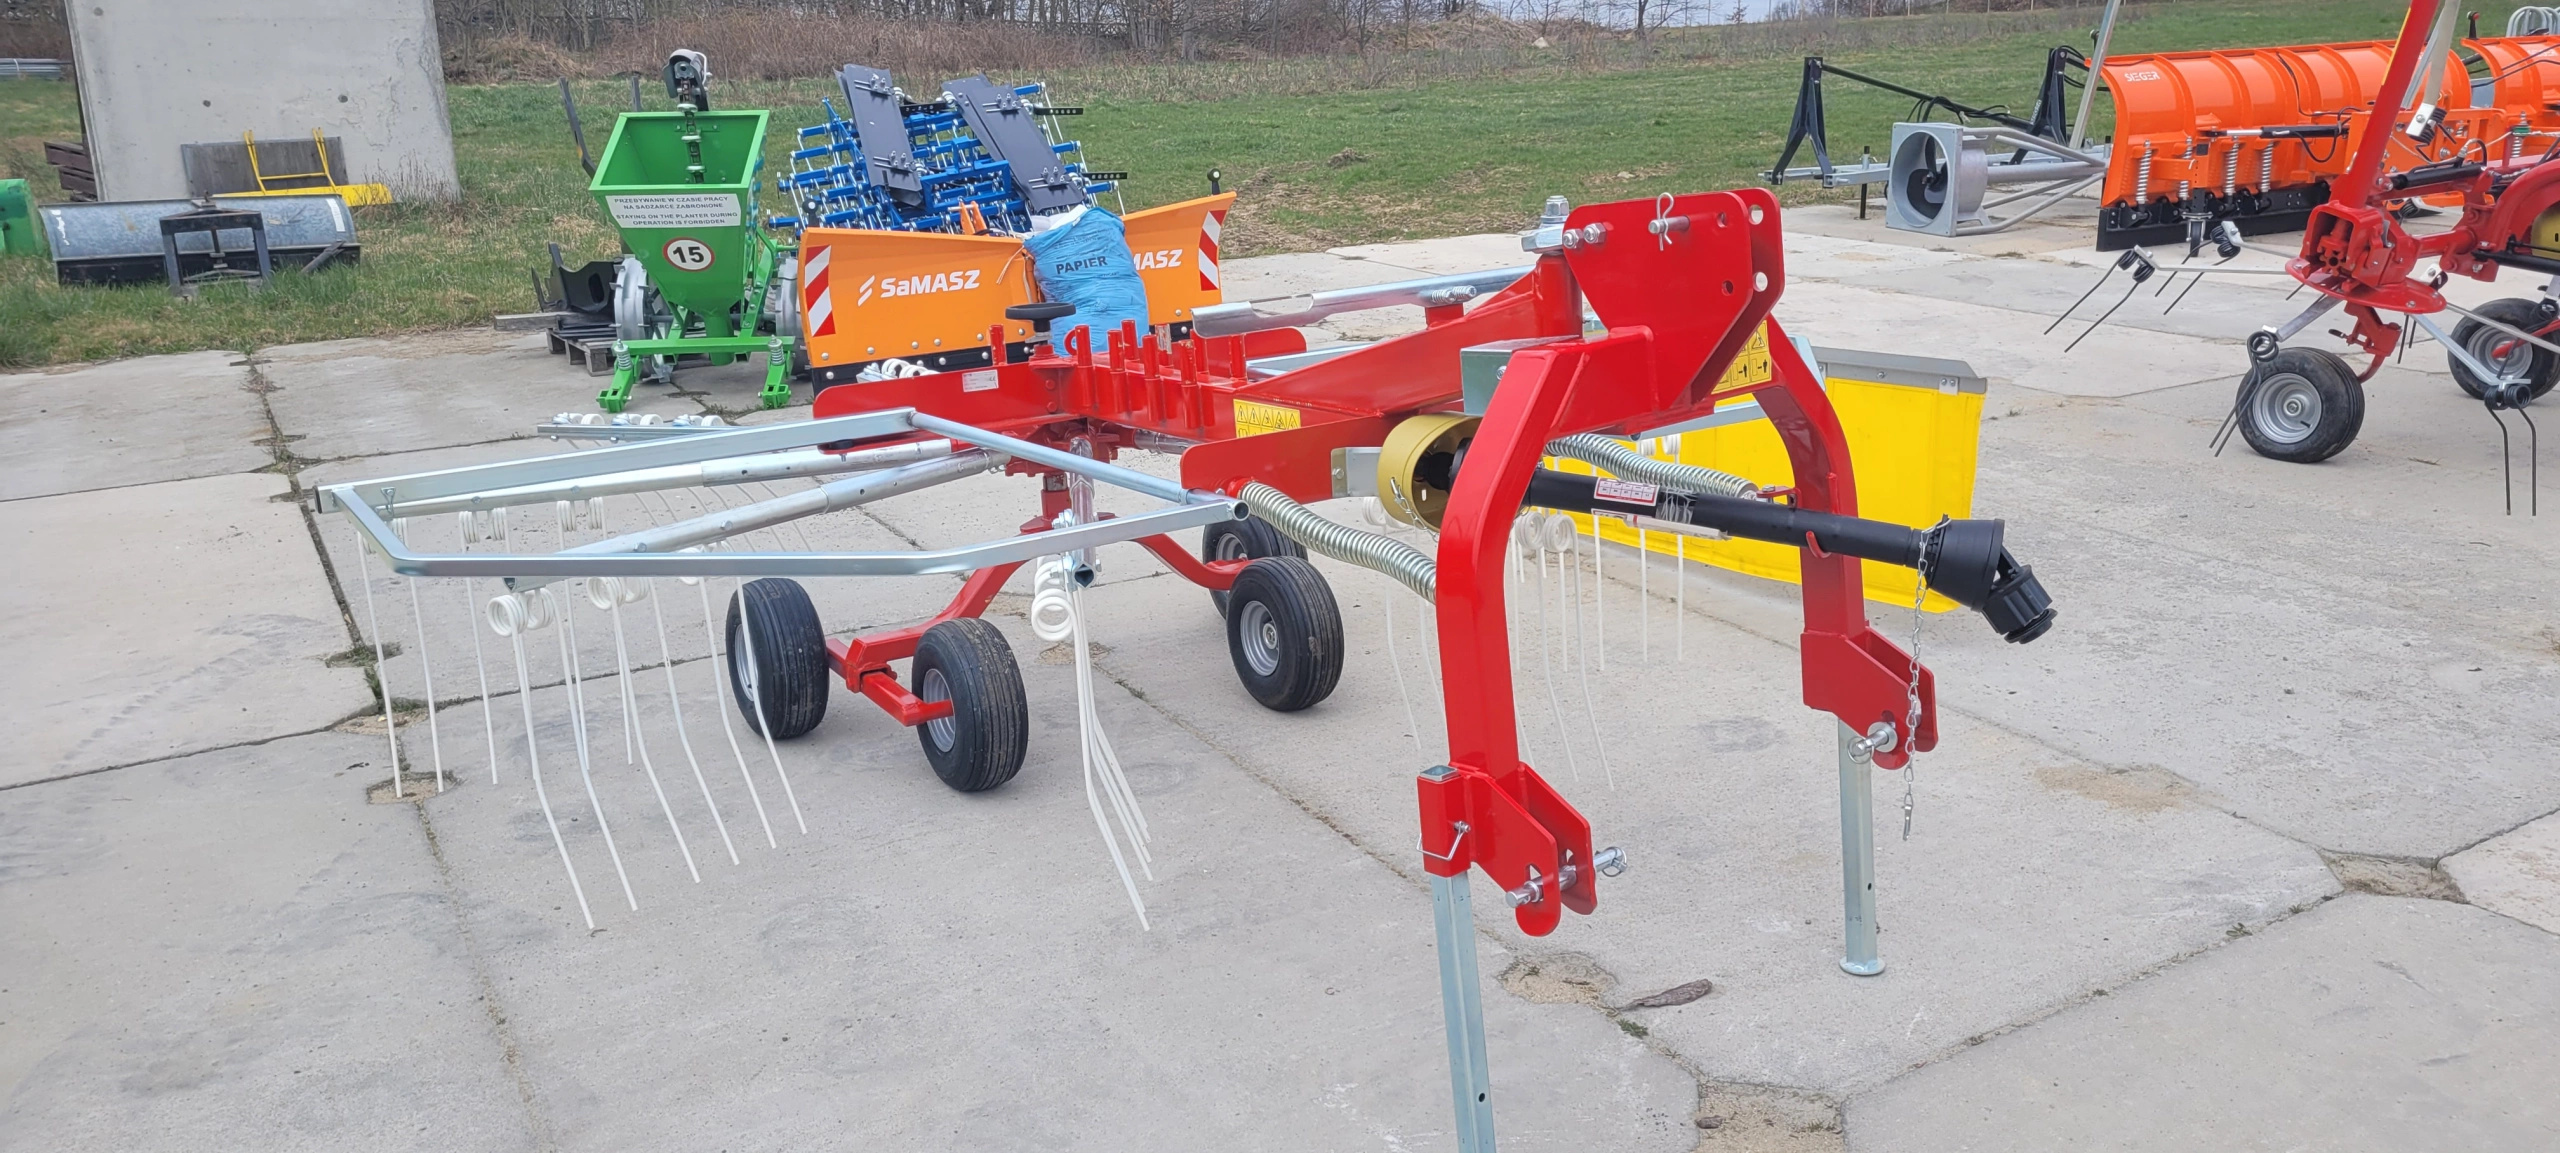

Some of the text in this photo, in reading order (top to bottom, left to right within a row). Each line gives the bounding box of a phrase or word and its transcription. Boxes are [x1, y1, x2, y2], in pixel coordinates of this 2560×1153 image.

[2124, 71, 2160, 82] SIEGER
[673, 246, 704, 264] 15
[1056, 256, 1108, 274] PAPIER
[880, 269, 980, 298] SaMASZ
